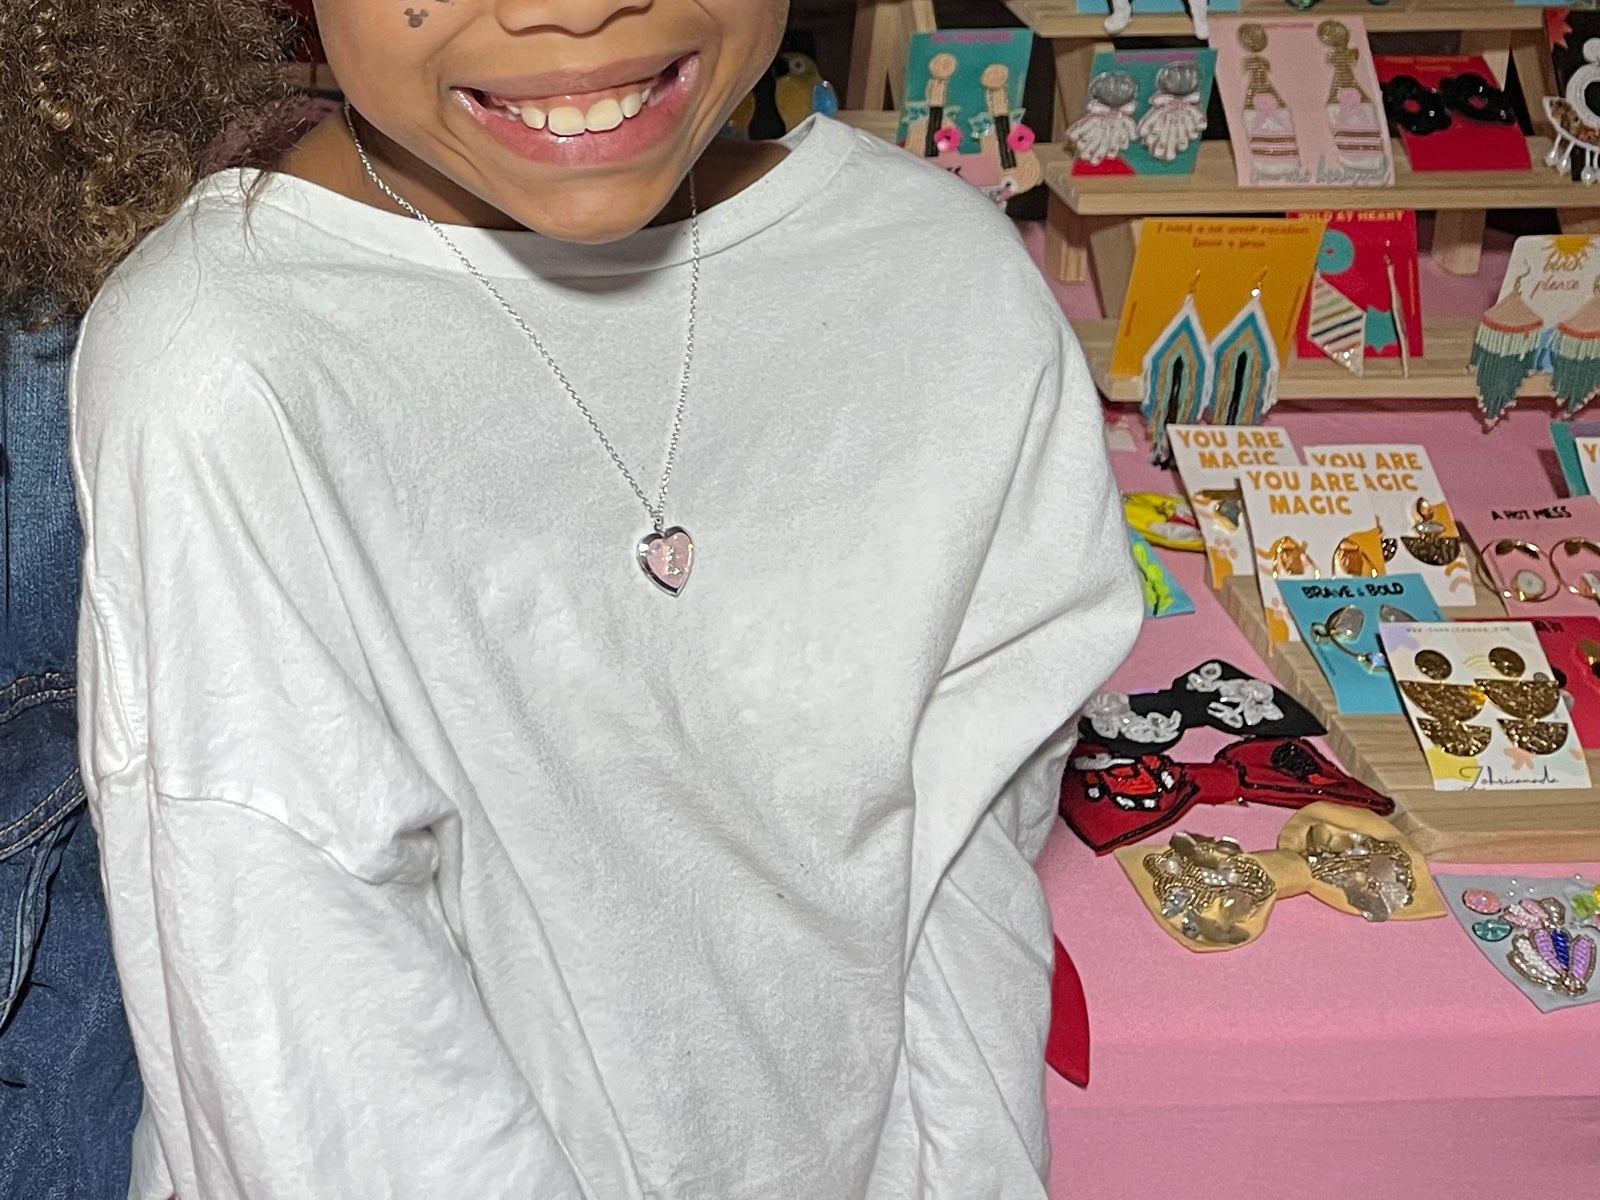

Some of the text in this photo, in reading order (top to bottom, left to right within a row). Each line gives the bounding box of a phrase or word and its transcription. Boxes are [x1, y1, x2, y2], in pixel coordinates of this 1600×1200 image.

[1358, 210, 1404, 222] HEART
[1176, 430, 1284, 449] YOU ARE
[1198, 451, 1279, 469] MAGIC
[1311, 452, 1423, 471] YOU ARE
[1246, 470, 1359, 492] YOU ARE
[1363, 473, 1419, 492] AGIC
[1269, 495, 1353, 515] MAGIC
[1532, 505, 1572, 520] MESS
[1302, 584, 1355, 599] BRAVE
[1365, 582, 1404, 597] BOLD
